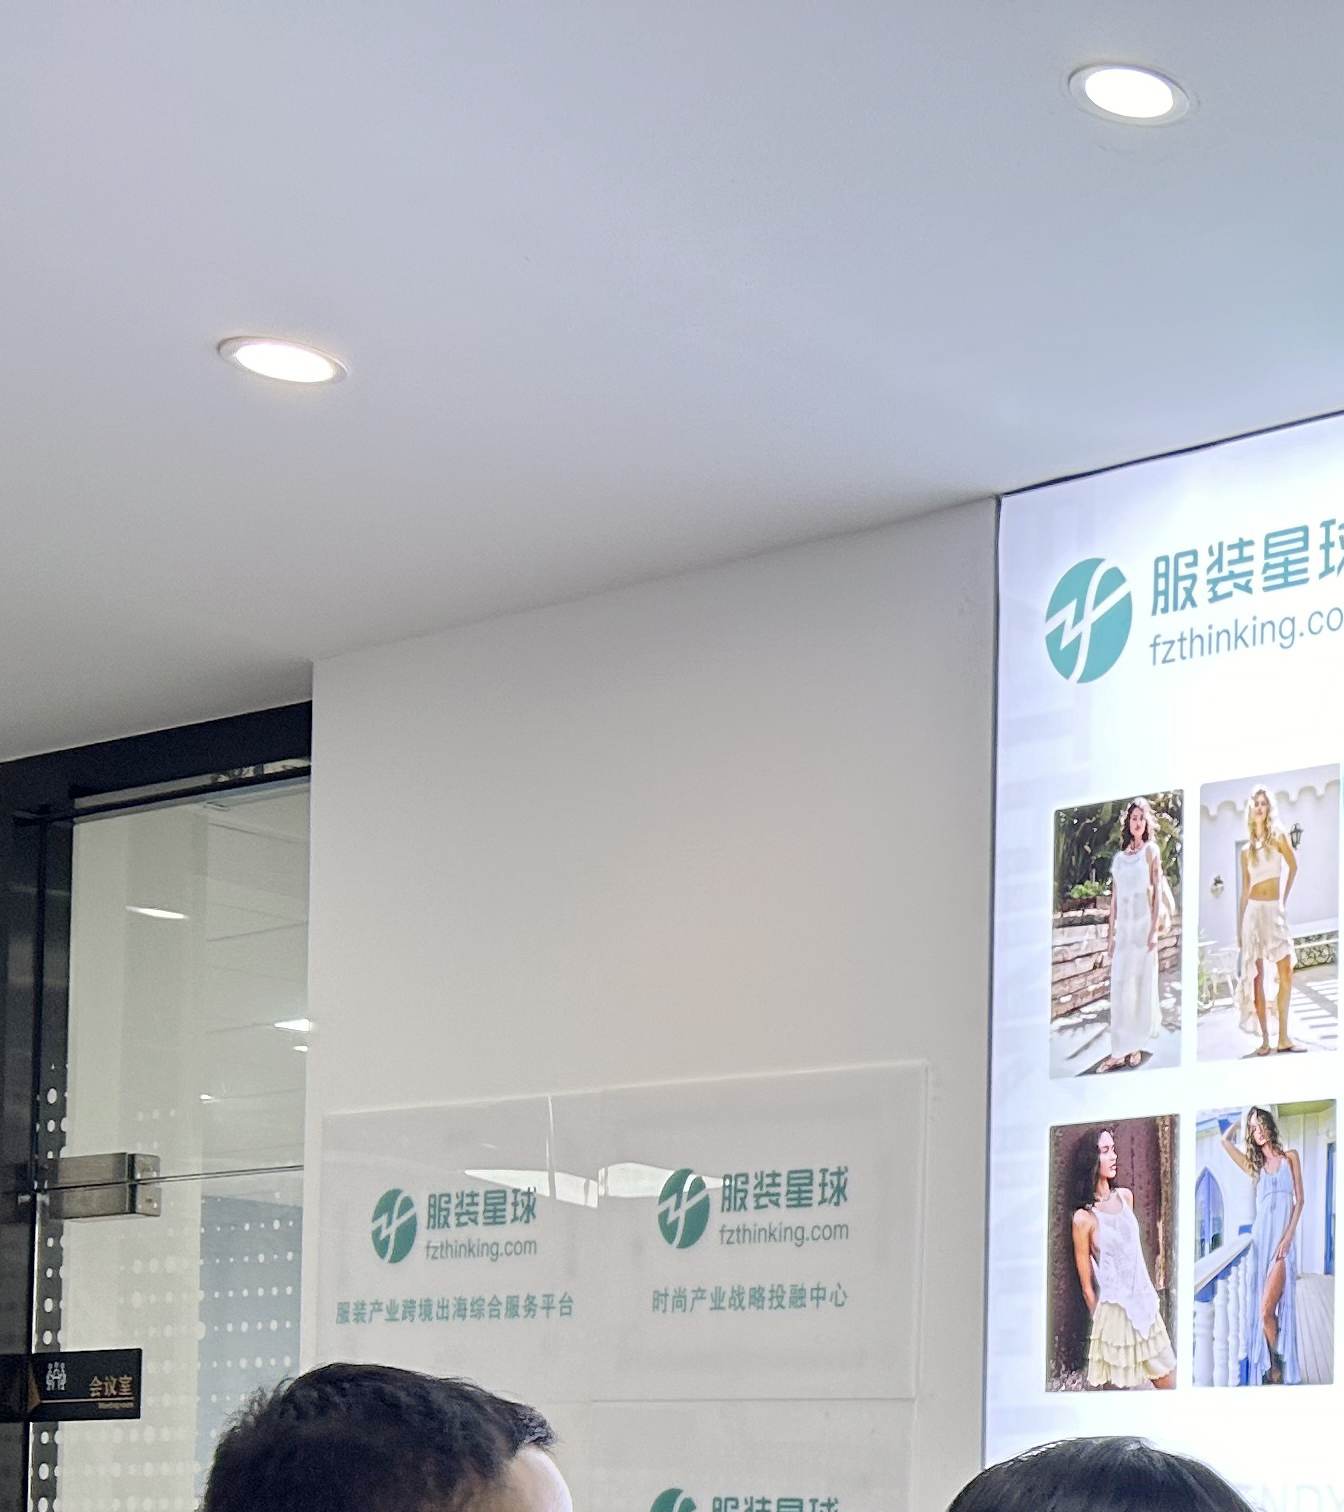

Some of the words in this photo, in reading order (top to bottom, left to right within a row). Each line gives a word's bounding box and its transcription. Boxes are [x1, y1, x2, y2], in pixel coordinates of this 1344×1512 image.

[720, 1165, 848, 1213] 服装星球
[426, 1186, 537, 1230] 服装星球
[425, 1239, 538, 1262] fzthinking.com
[719, 1222, 849, 1248] fzthinking.com
[335, 1291, 574, 1325] 服装产业跨境出海综合服务平台
[651, 1282, 848, 1314] 时尚产业战略投融中心
[88, 1374, 133, 1397] 会议室
